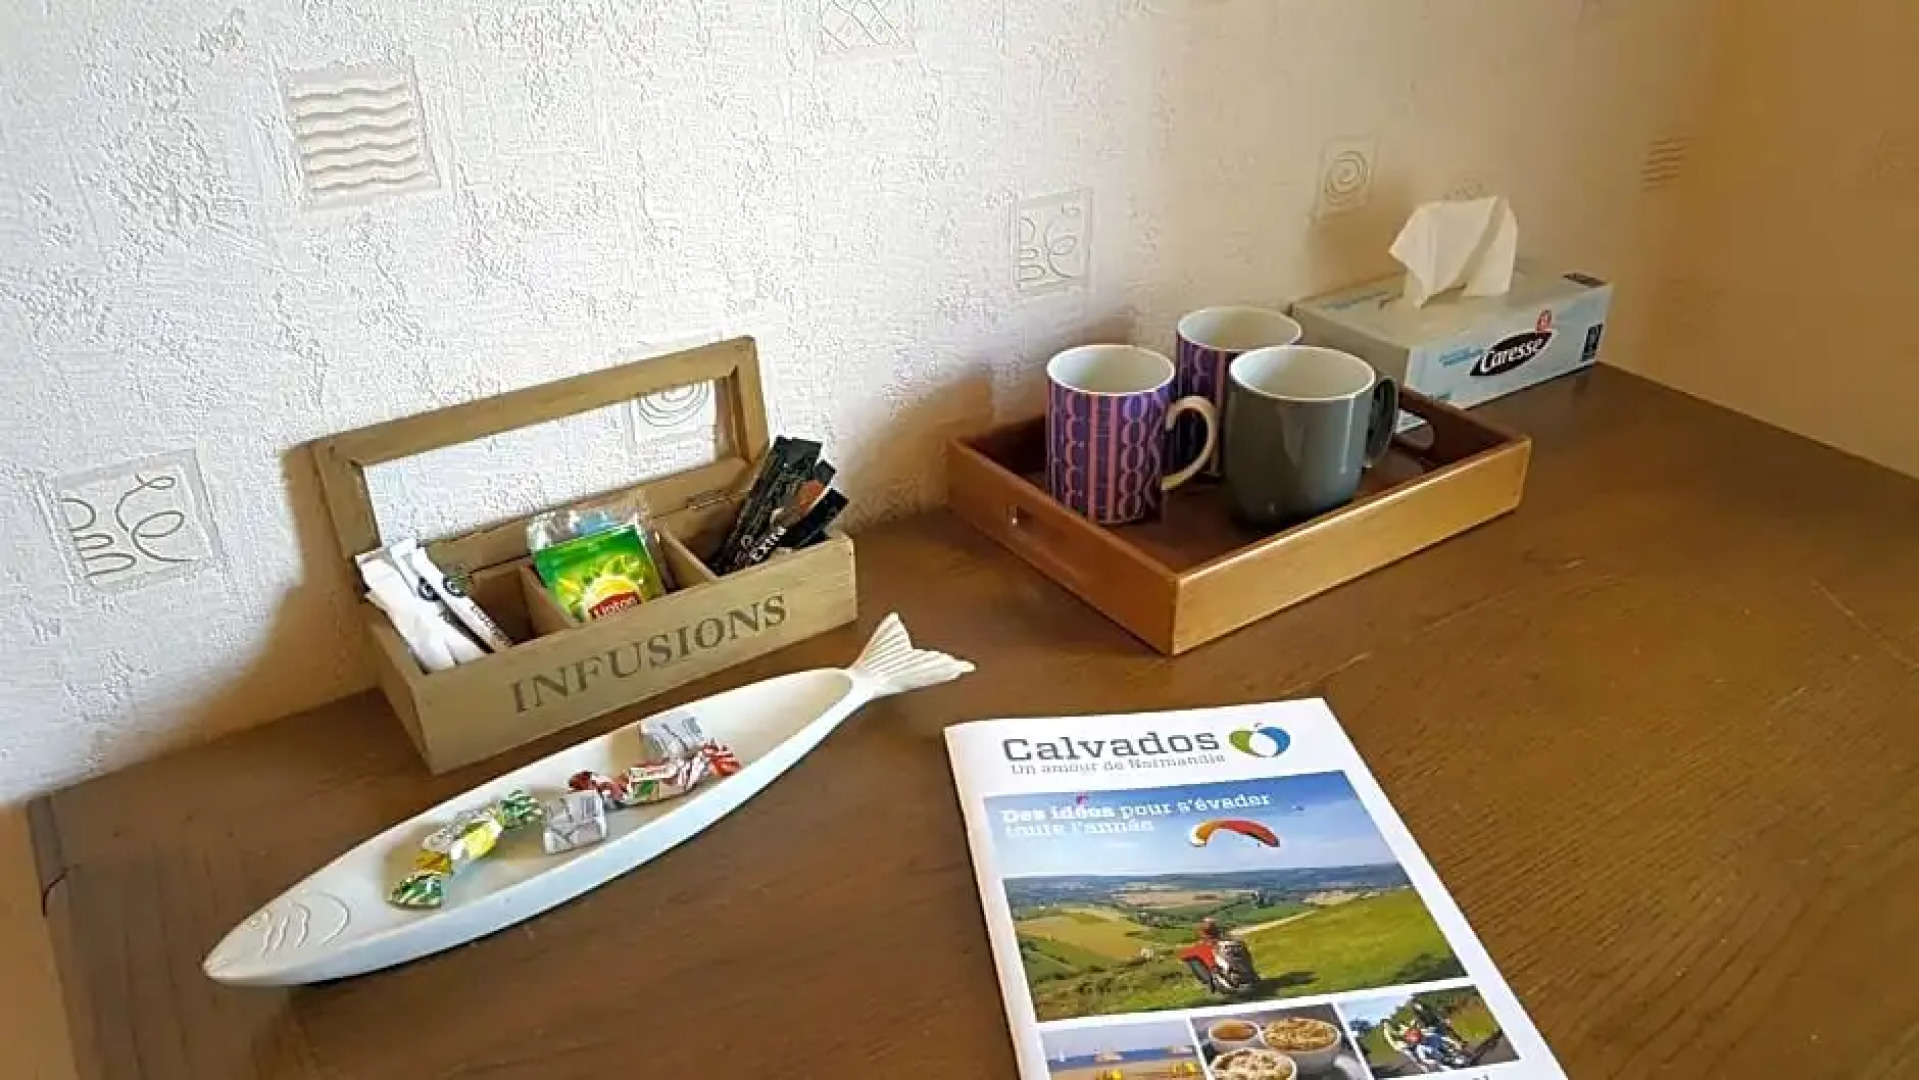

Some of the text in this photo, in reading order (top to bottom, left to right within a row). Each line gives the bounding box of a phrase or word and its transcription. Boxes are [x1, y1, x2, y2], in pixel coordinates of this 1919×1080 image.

[1480, 338, 1544, 374] Caresse
[510, 595, 787, 714] INFUSIONS
[1002, 731, 1220, 762] Calvados
[1010, 752, 1226, 776] Un amour de Normandie
[1000, 807, 1047, 822] Des
[1120, 801, 1172, 818] pour
[1177, 793, 1271, 814] s'évader
[1005, 819, 1154, 836] toute l'année
